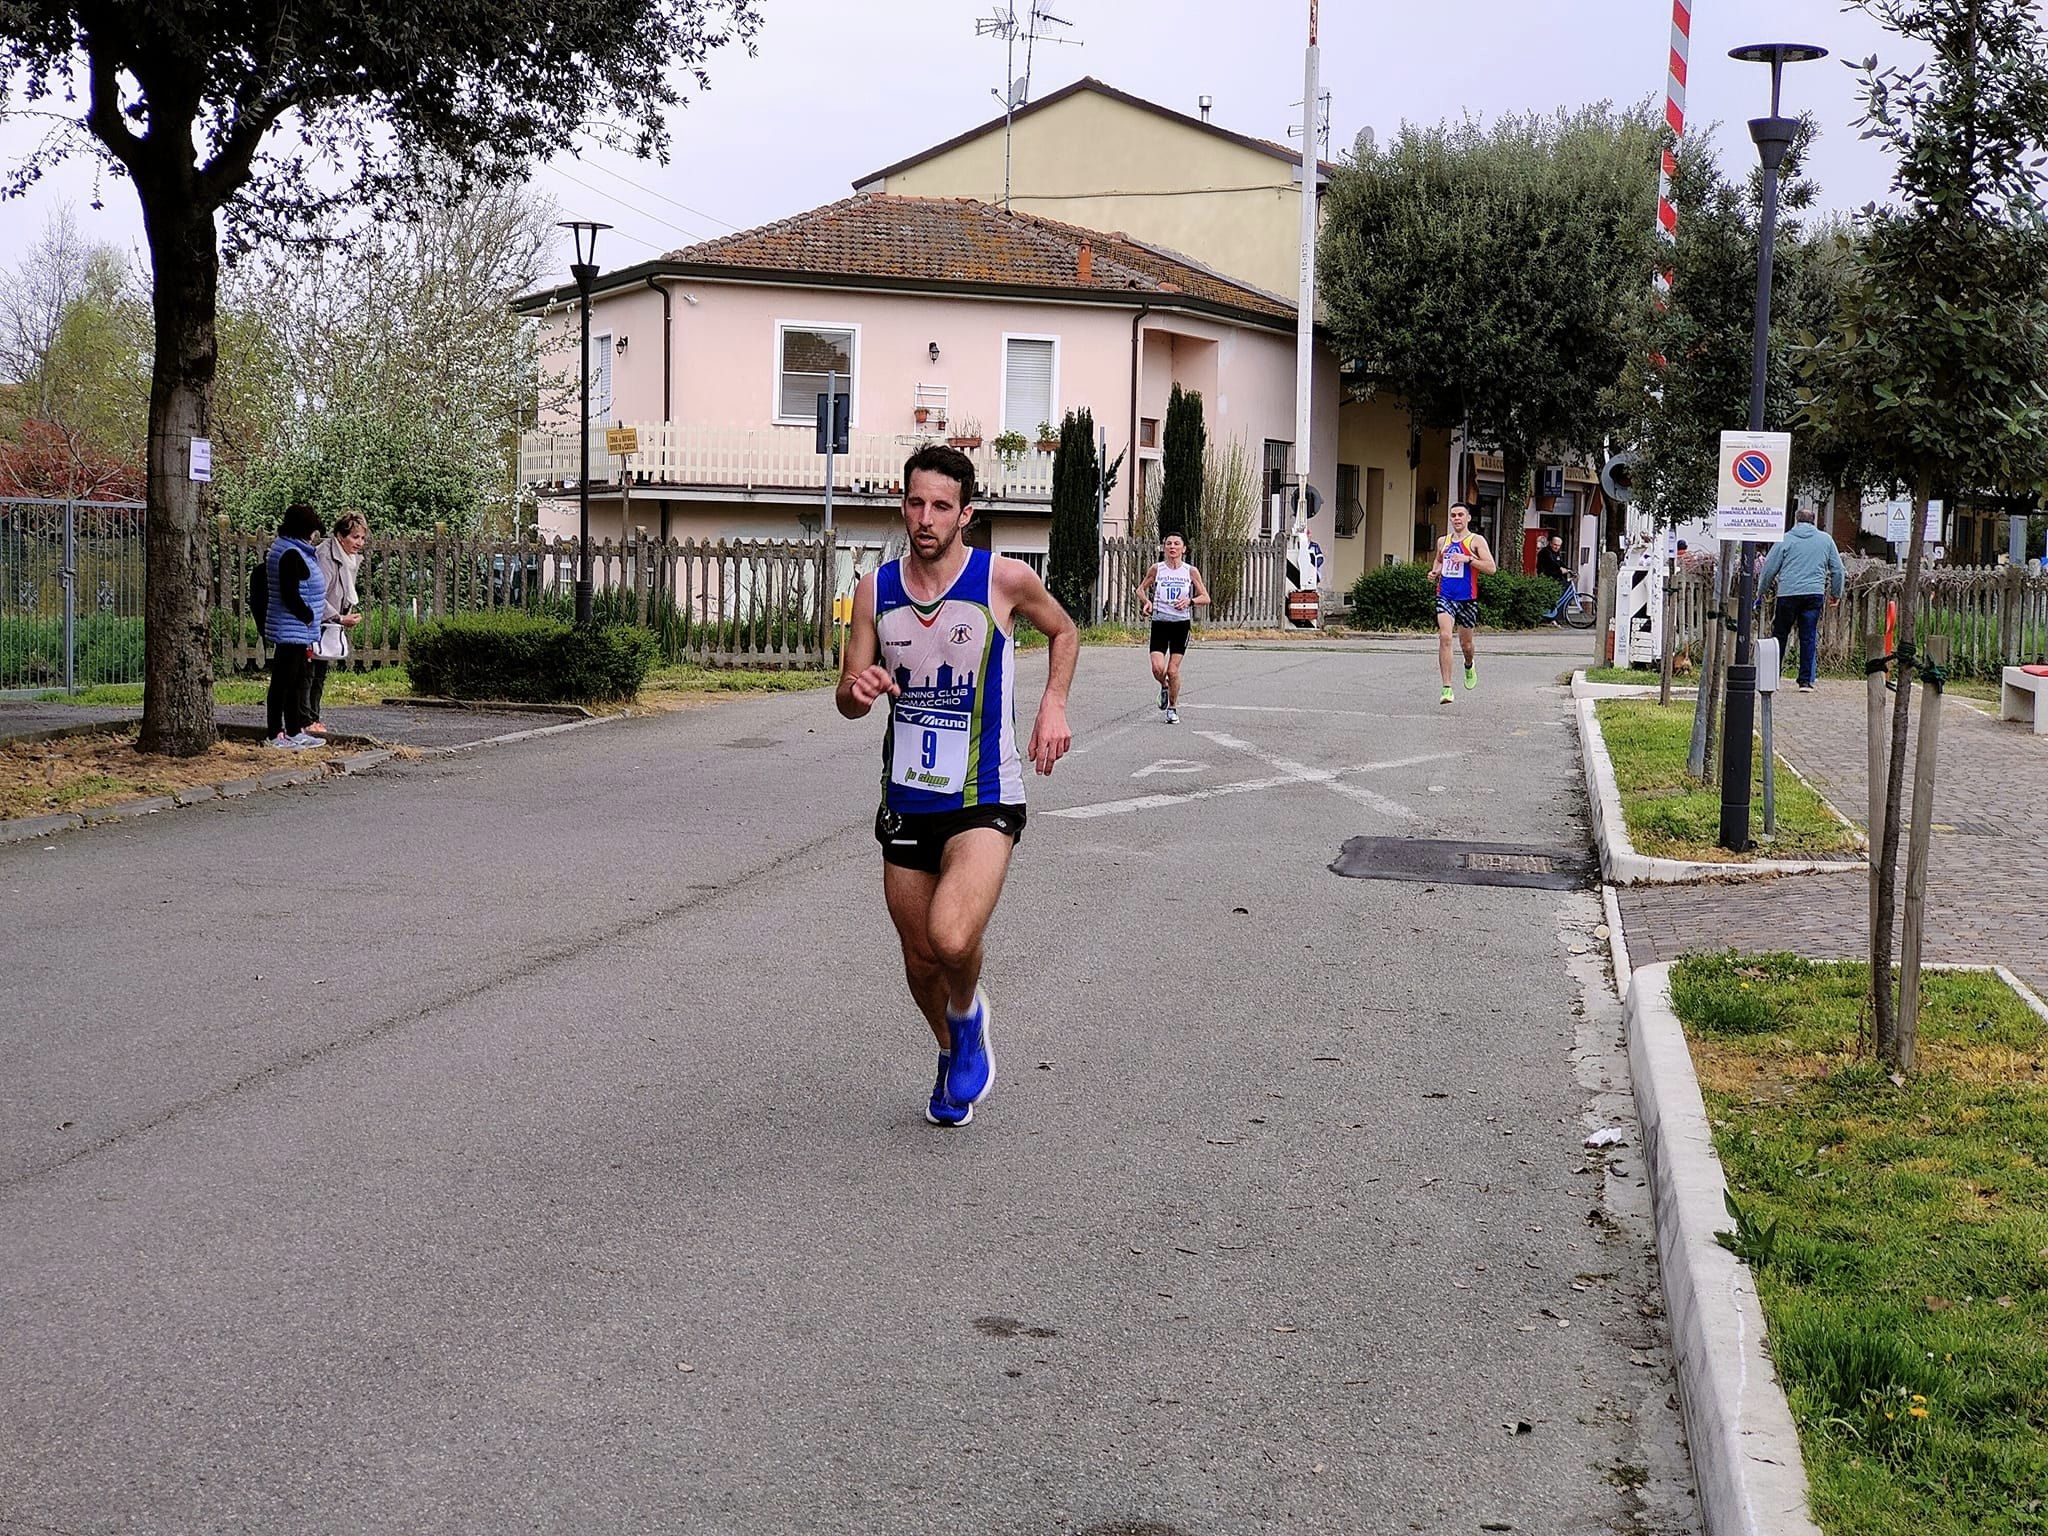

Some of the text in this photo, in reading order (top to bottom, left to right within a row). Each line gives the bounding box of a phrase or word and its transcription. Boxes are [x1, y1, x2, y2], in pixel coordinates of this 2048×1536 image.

[1166, 587, 1182, 600] 162
[938, 688, 969, 698] CLUB
[921, 730, 937, 769] 9
